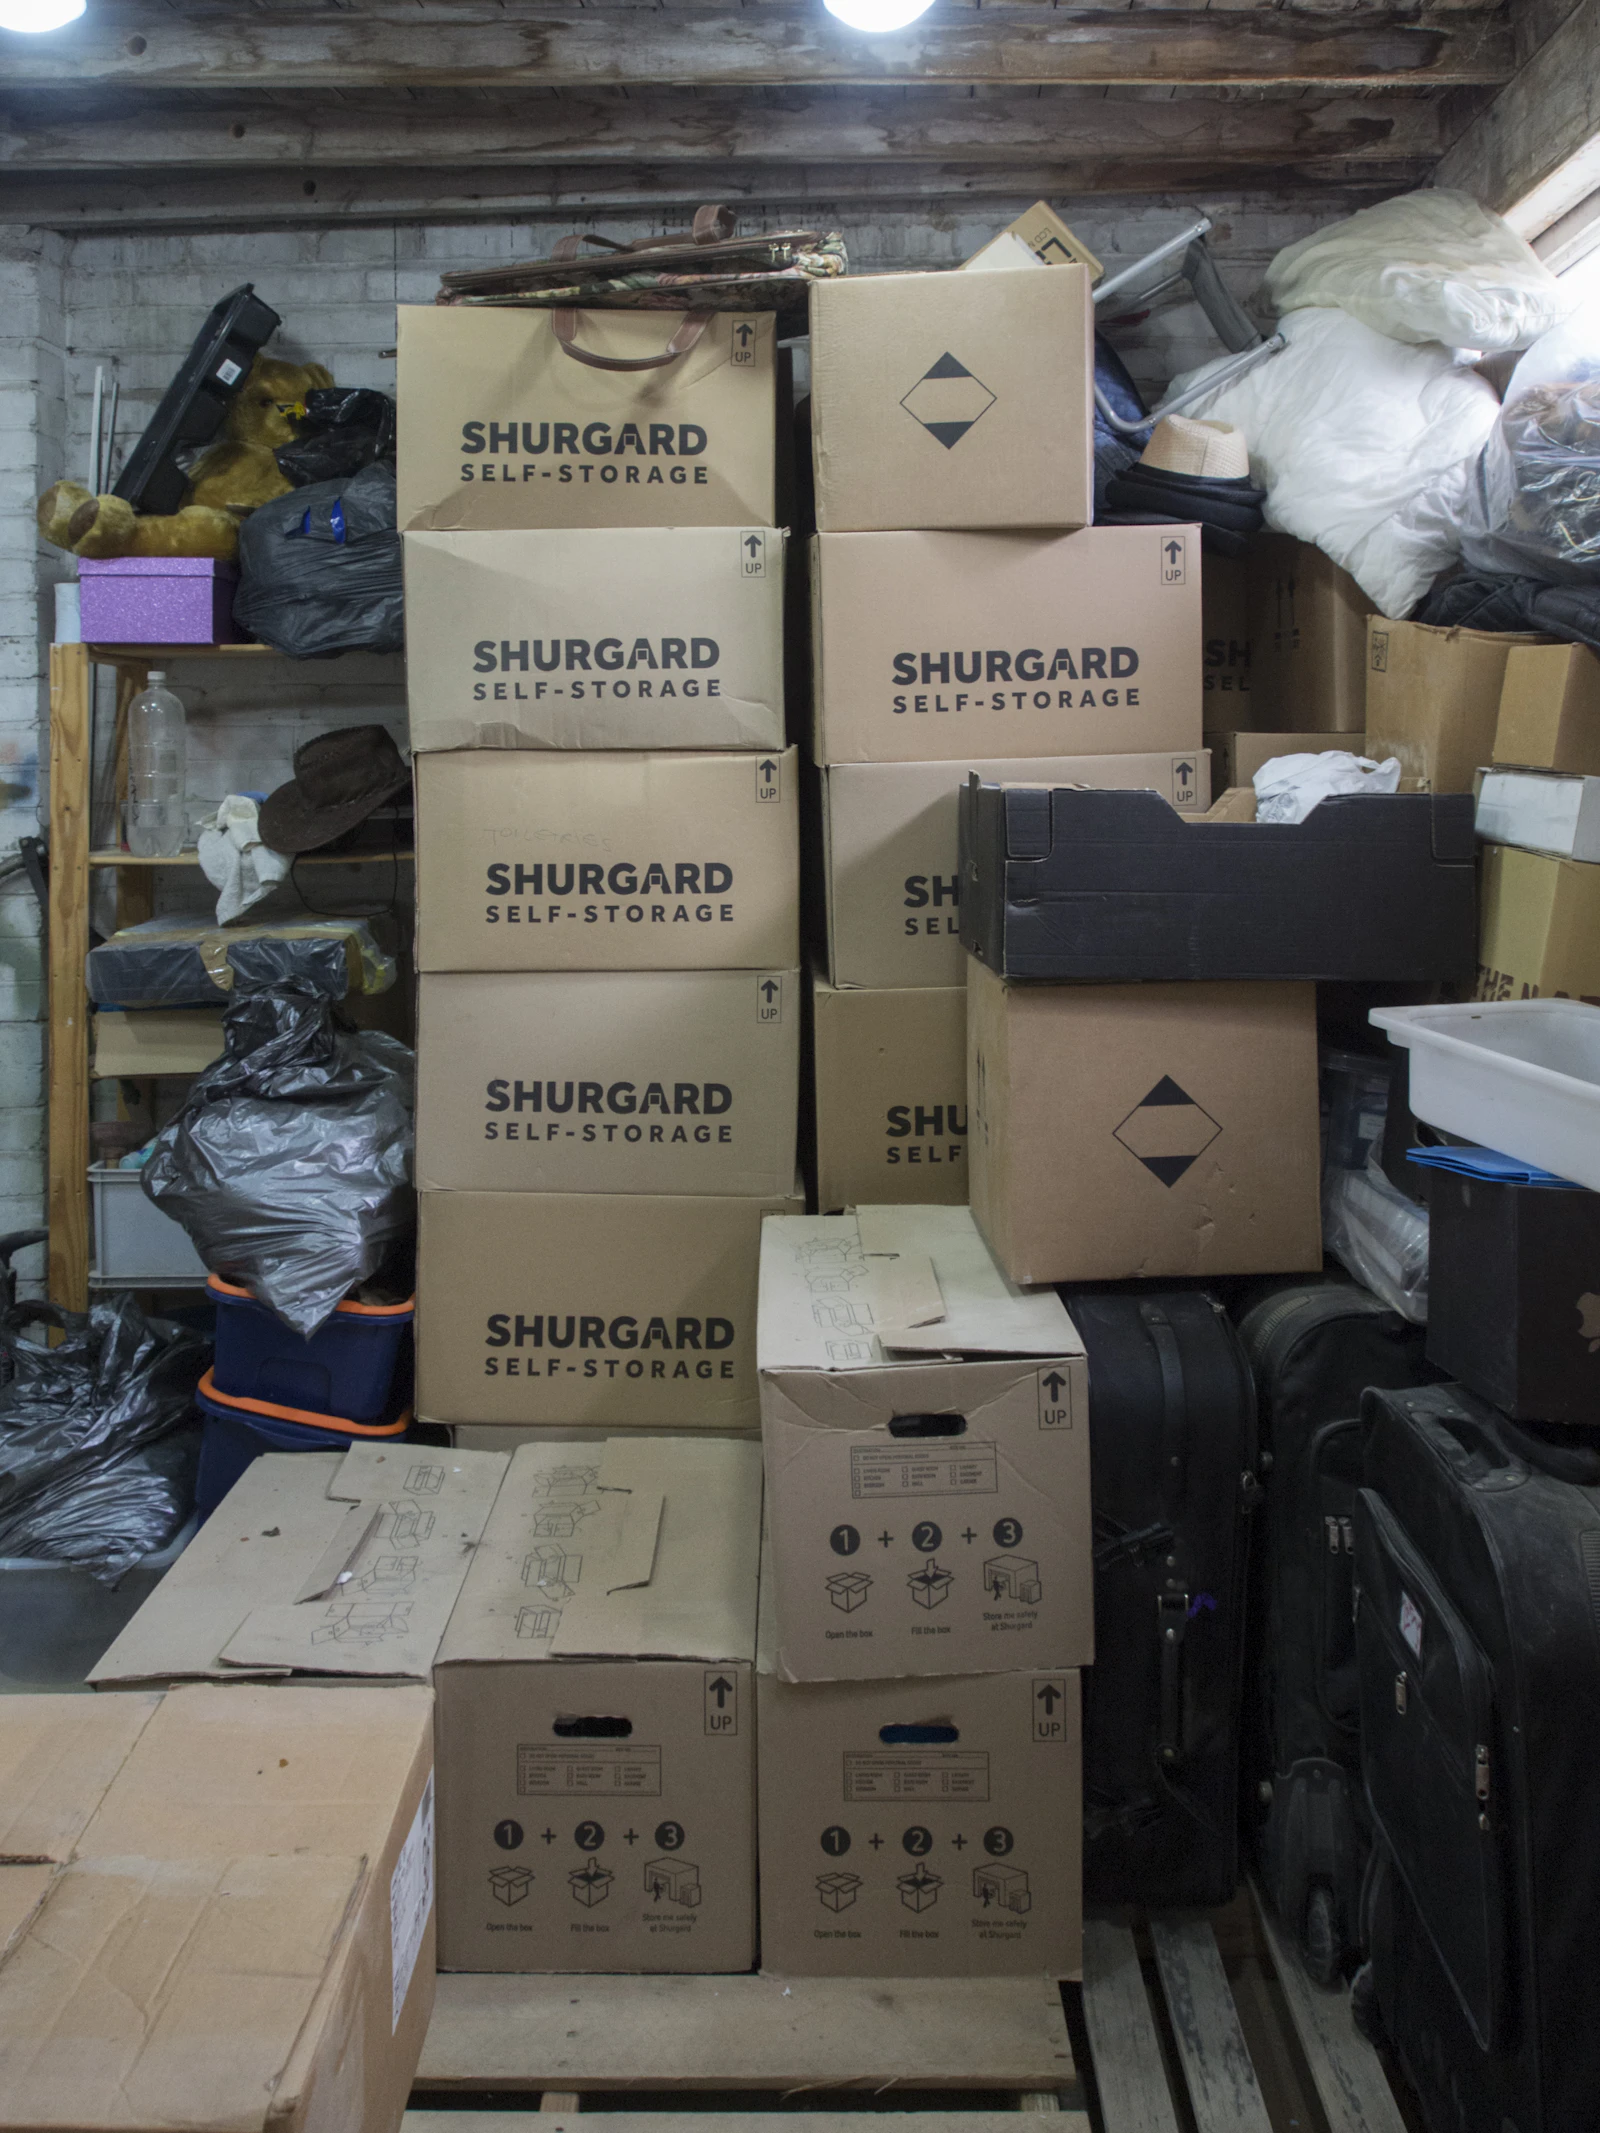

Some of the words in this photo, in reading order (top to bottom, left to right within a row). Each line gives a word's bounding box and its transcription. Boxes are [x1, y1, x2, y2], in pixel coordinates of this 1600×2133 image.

[734, 351, 752, 364] UP
[460, 421, 708, 456] SHURGARD
[460, 463, 708, 485] SELF-STORAGE
[745, 562, 763, 575] UP
[1165, 569, 1183, 582] UP
[472, 637, 720, 674] SHURGARD
[892, 646, 1140, 687] SHURGARD
[473, 679, 721, 702] SELF-STORAGE
[893, 687, 1140, 714] SELF-STORAGE
[760, 787, 777, 800] UP
[1176, 790, 1194, 804] UP
[485, 862, 733, 896] SHURGARD
[485, 904, 734, 924] SELF-STORAGE
[761, 1008, 778, 1021] UP
[485, 1079, 733, 1116] SHURGARD
[485, 1121, 732, 1144] SELF-STORAGE
[485, 1313, 736, 1351] SHURGARD
[484, 1356, 735, 1381] SELF-STORAGE
[1044, 1410, 1067, 1425] UP
[825, 1630, 844, 1640] Open
[846, 1630, 858, 1639] the
[859, 1629, 873, 1638] box
[911, 1626, 922, 1635] Fill
[923, 1626, 935, 1635] the
[936, 1626, 950, 1635] box
[710, 1715, 732, 1731] UP
[1038, 1722, 1060, 1738] UP
